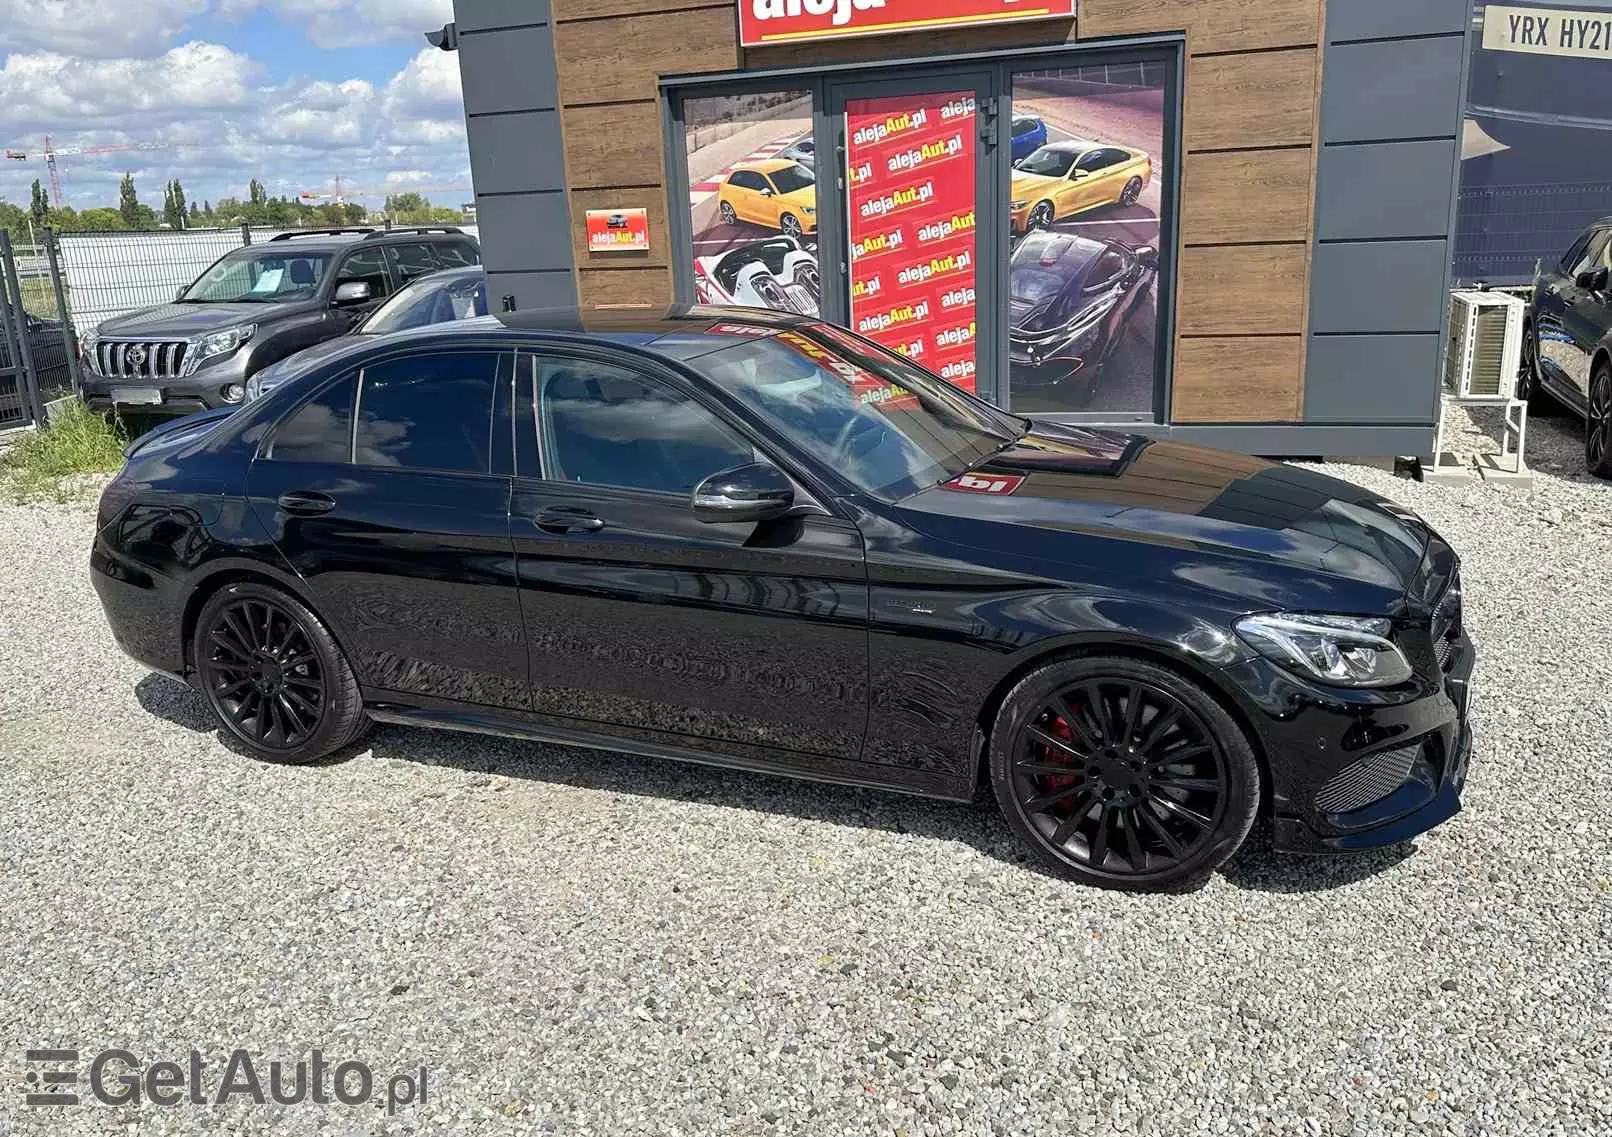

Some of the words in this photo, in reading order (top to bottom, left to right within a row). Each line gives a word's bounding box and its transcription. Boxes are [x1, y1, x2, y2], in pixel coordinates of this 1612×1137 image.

[1509, 15, 1549, 46] YRX
[1559, 18, 1612, 51] HY21
[941, 97, 976, 119] aleja
[853, 108, 928, 145] alejaAut.pl
[887, 135, 963, 172] alejaAut.pl
[860, 182, 934, 217] alejaAut.pl
[592, 230, 645, 246] alejaAut.pl
[918, 211, 976, 241] alejaAut
[898, 251, 971, 284] alejaAut.pl
[941, 287, 976, 308] aleja
[859, 301, 929, 332] alejaAut.pl
[940, 360, 976, 378] aleja
